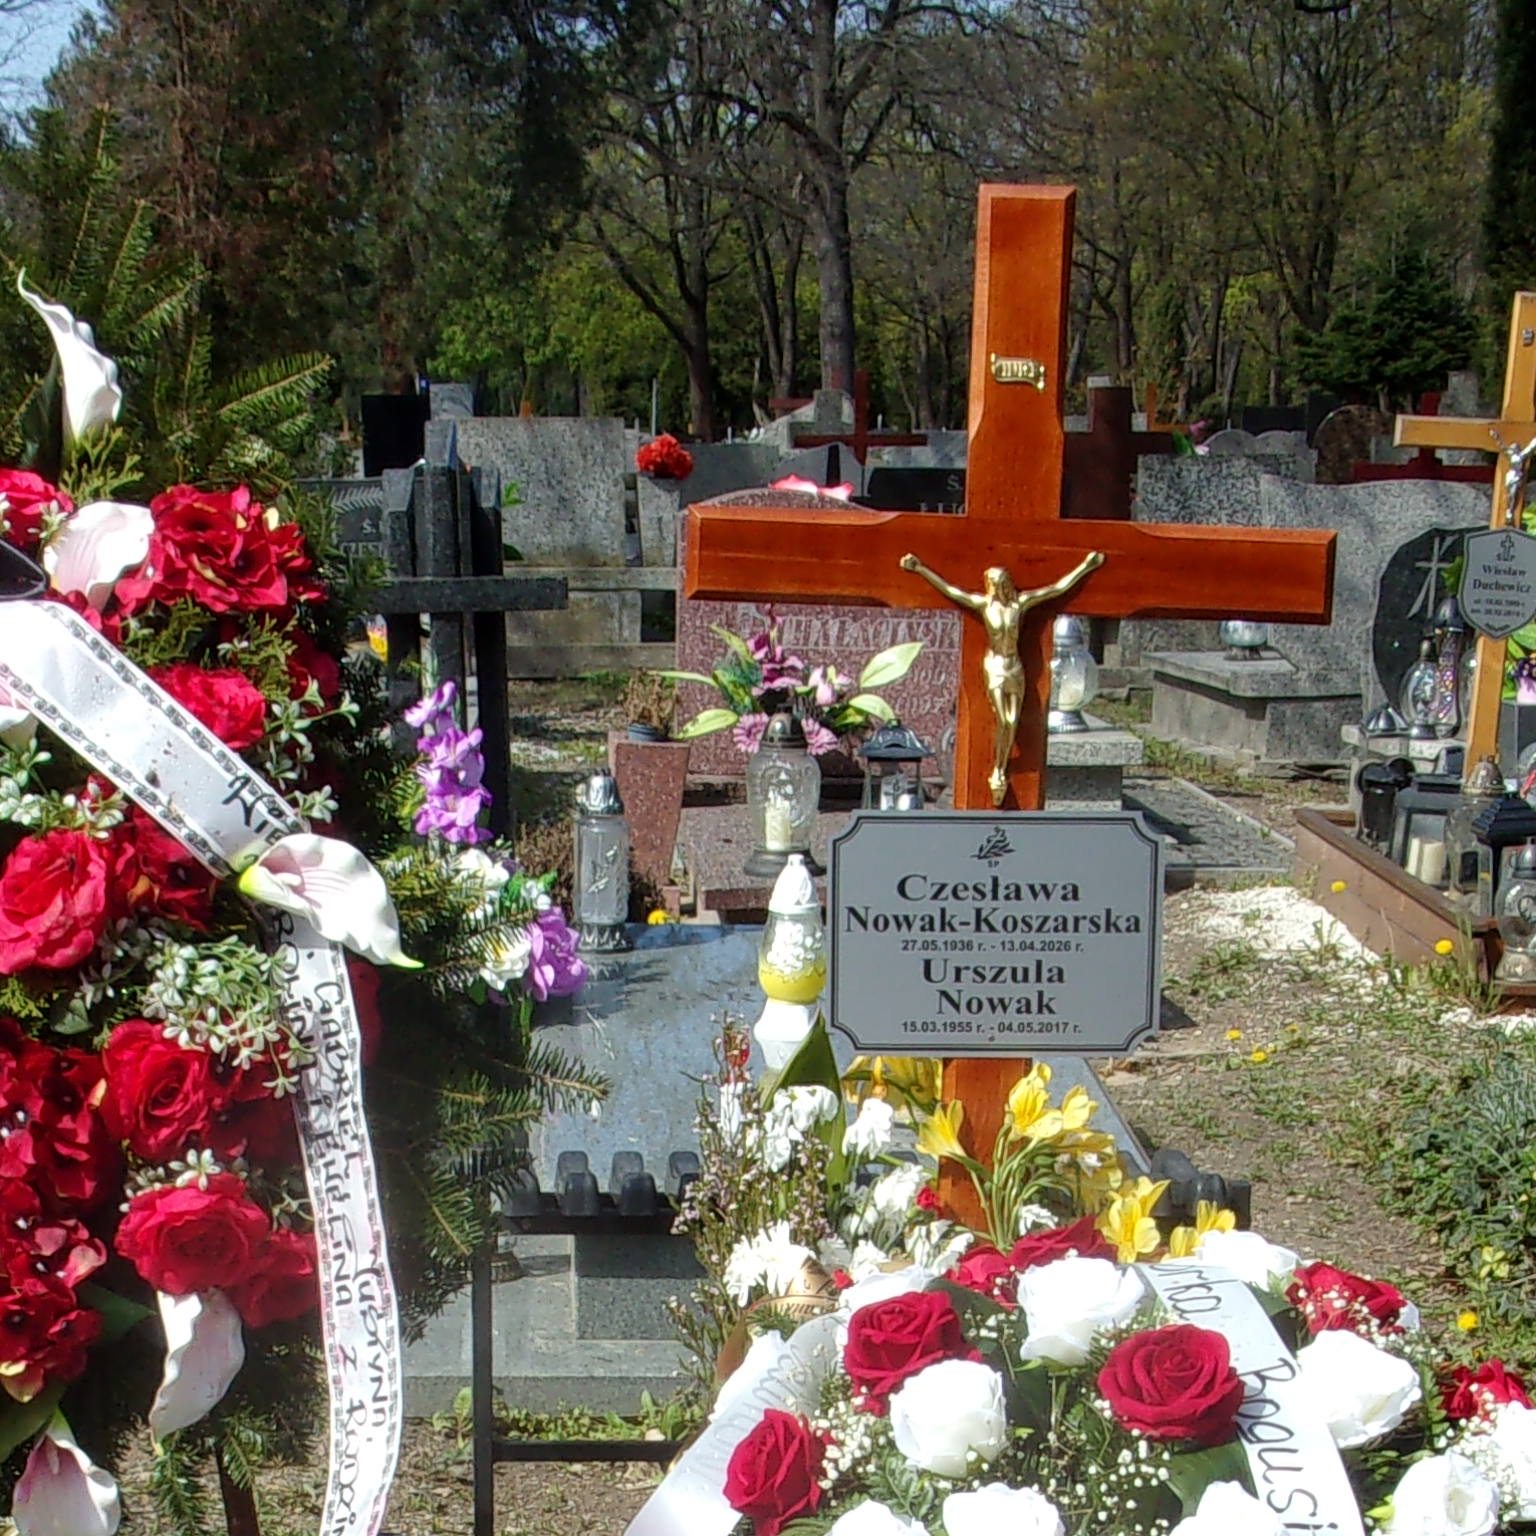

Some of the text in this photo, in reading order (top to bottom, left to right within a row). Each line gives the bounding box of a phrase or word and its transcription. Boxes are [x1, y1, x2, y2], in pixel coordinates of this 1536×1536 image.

[896, 873, 1081, 902] Czesława
[844, 905, 1142, 934] Nowak-Koszarska
[901, 939, 974, 952] 27.05.1936
[1000, 940, 1072, 953] 13.04.2026
[922, 957, 1066, 985] Urszula
[935, 989, 1057, 1016] Nowak
[901, 1021, 973, 1034] 15.03.1955
[998, 1021, 1070, 1034] 04.05.2017
[1234, 1356, 1339, 1533] Bogusi
